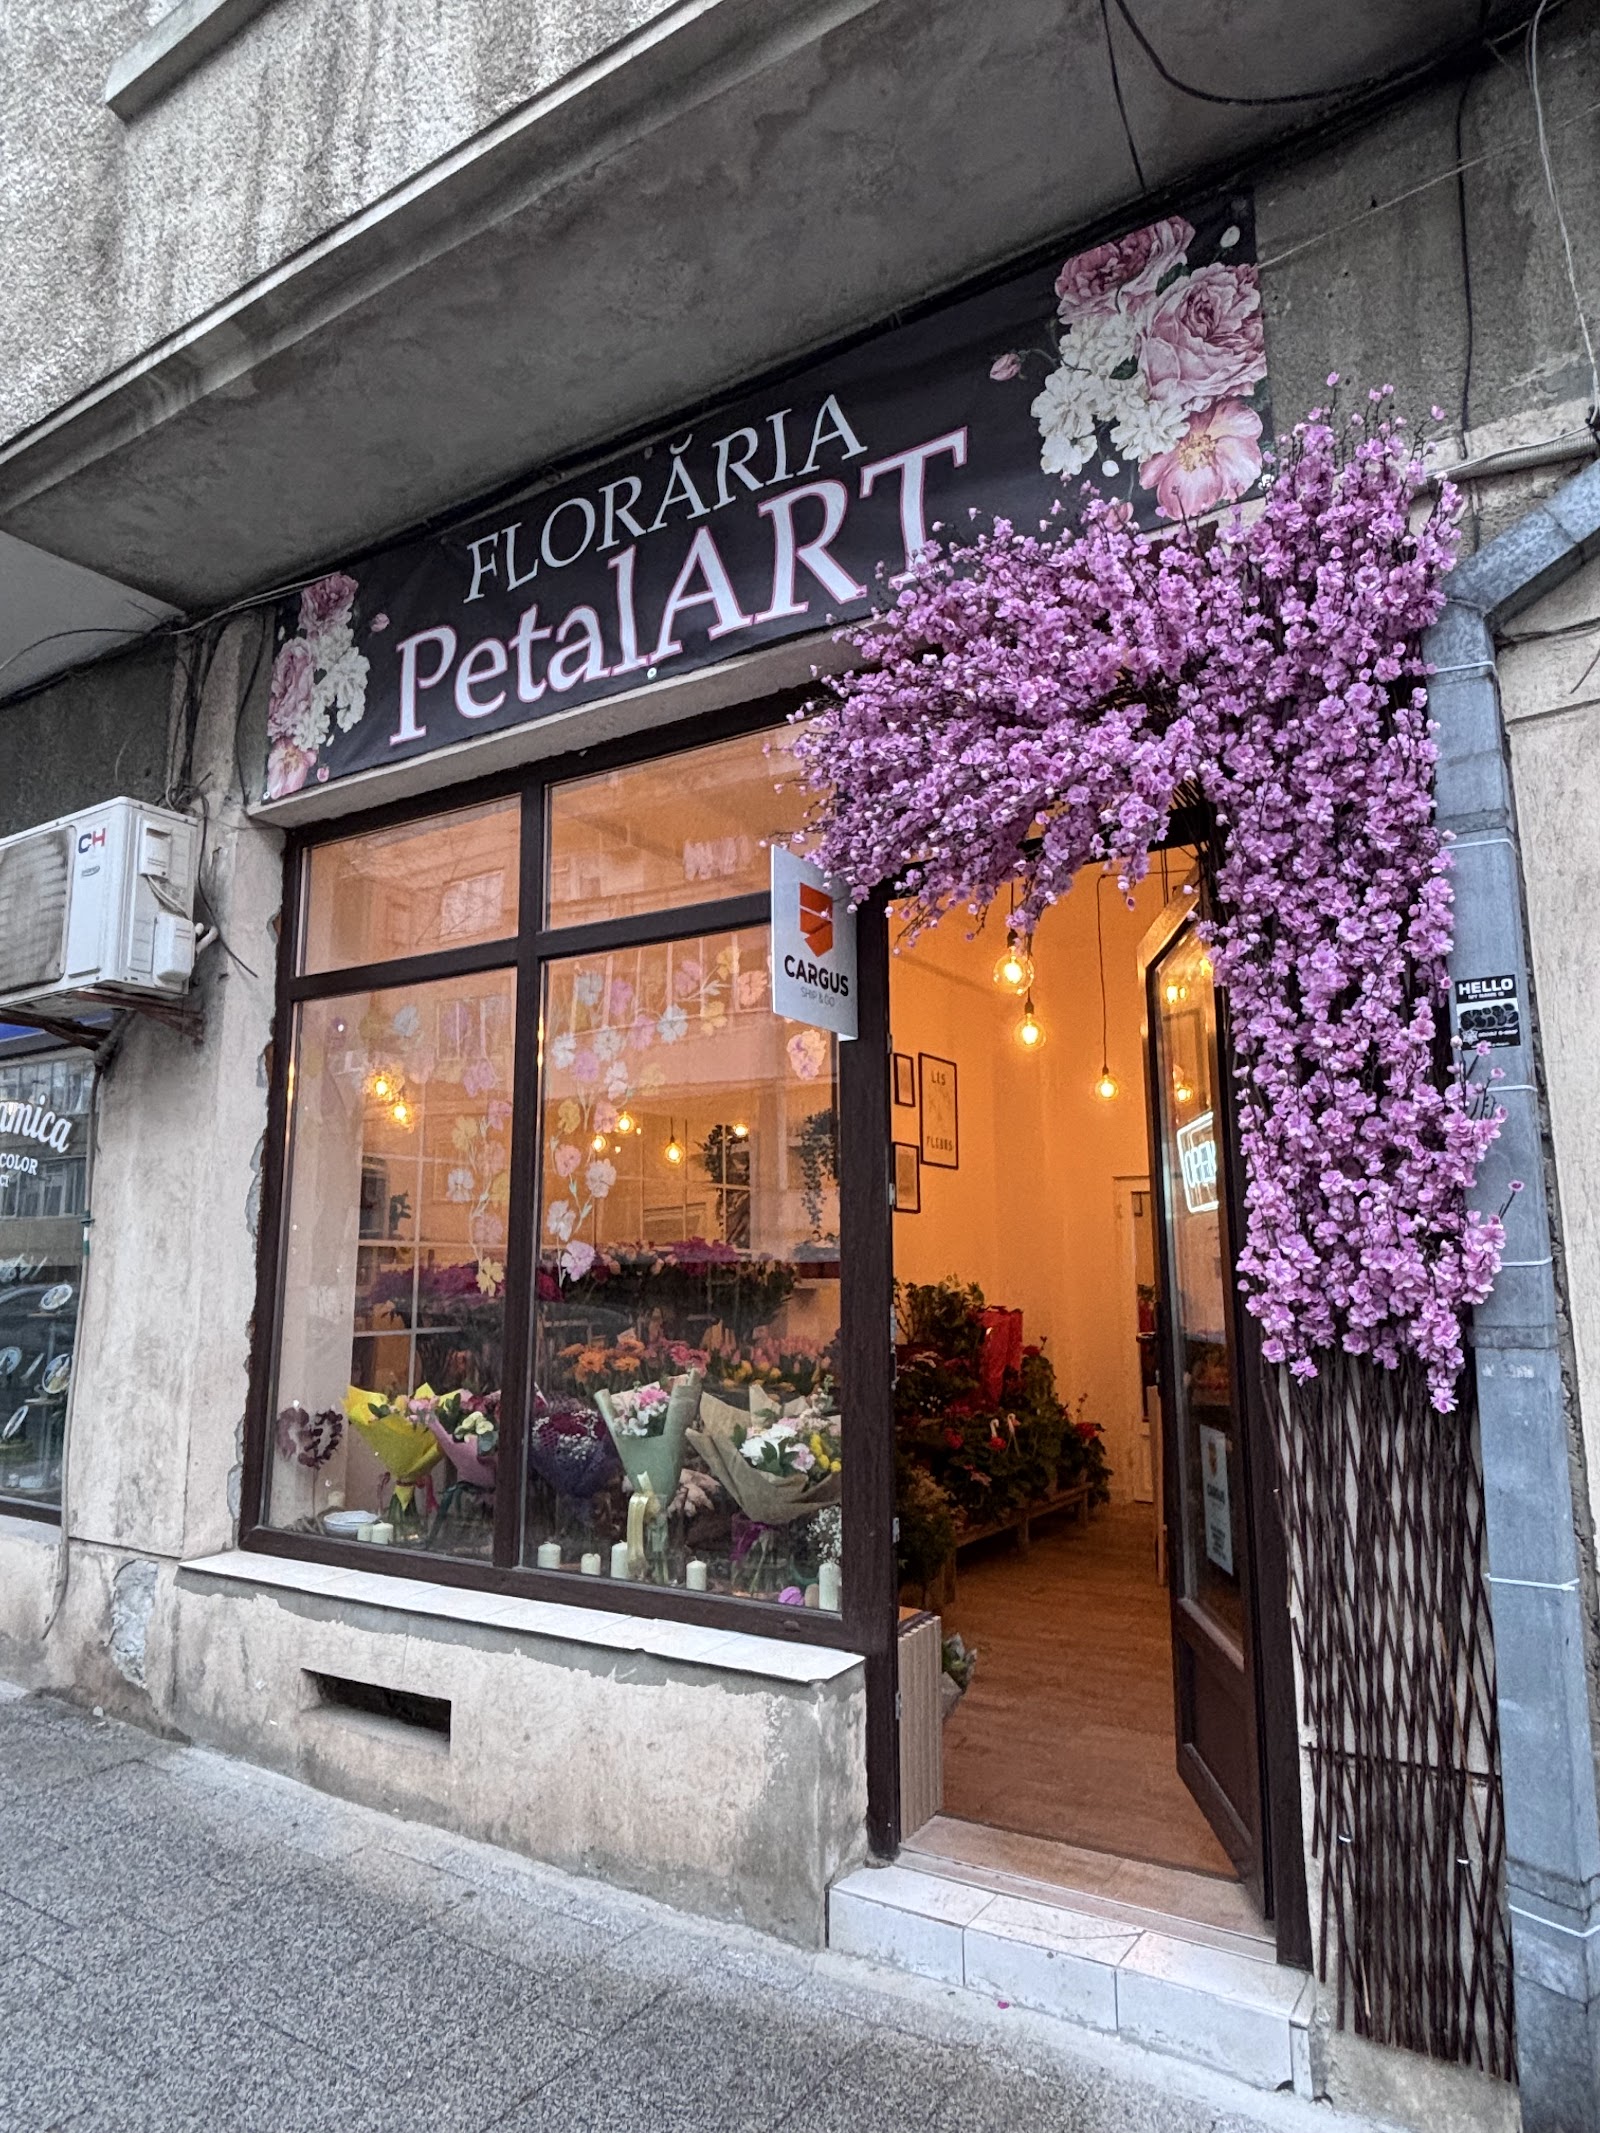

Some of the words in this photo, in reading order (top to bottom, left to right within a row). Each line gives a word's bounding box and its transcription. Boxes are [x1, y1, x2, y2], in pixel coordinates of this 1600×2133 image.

[462, 394, 868, 604] FLORĂRIA
[389, 426, 968, 747] PetalART
[78, 827, 106, 854] CH
[784, 954, 849, 997] CARGUS
[1458, 978, 1514, 995] HELLO
[1185, 1140, 1217, 1188] OPEN
